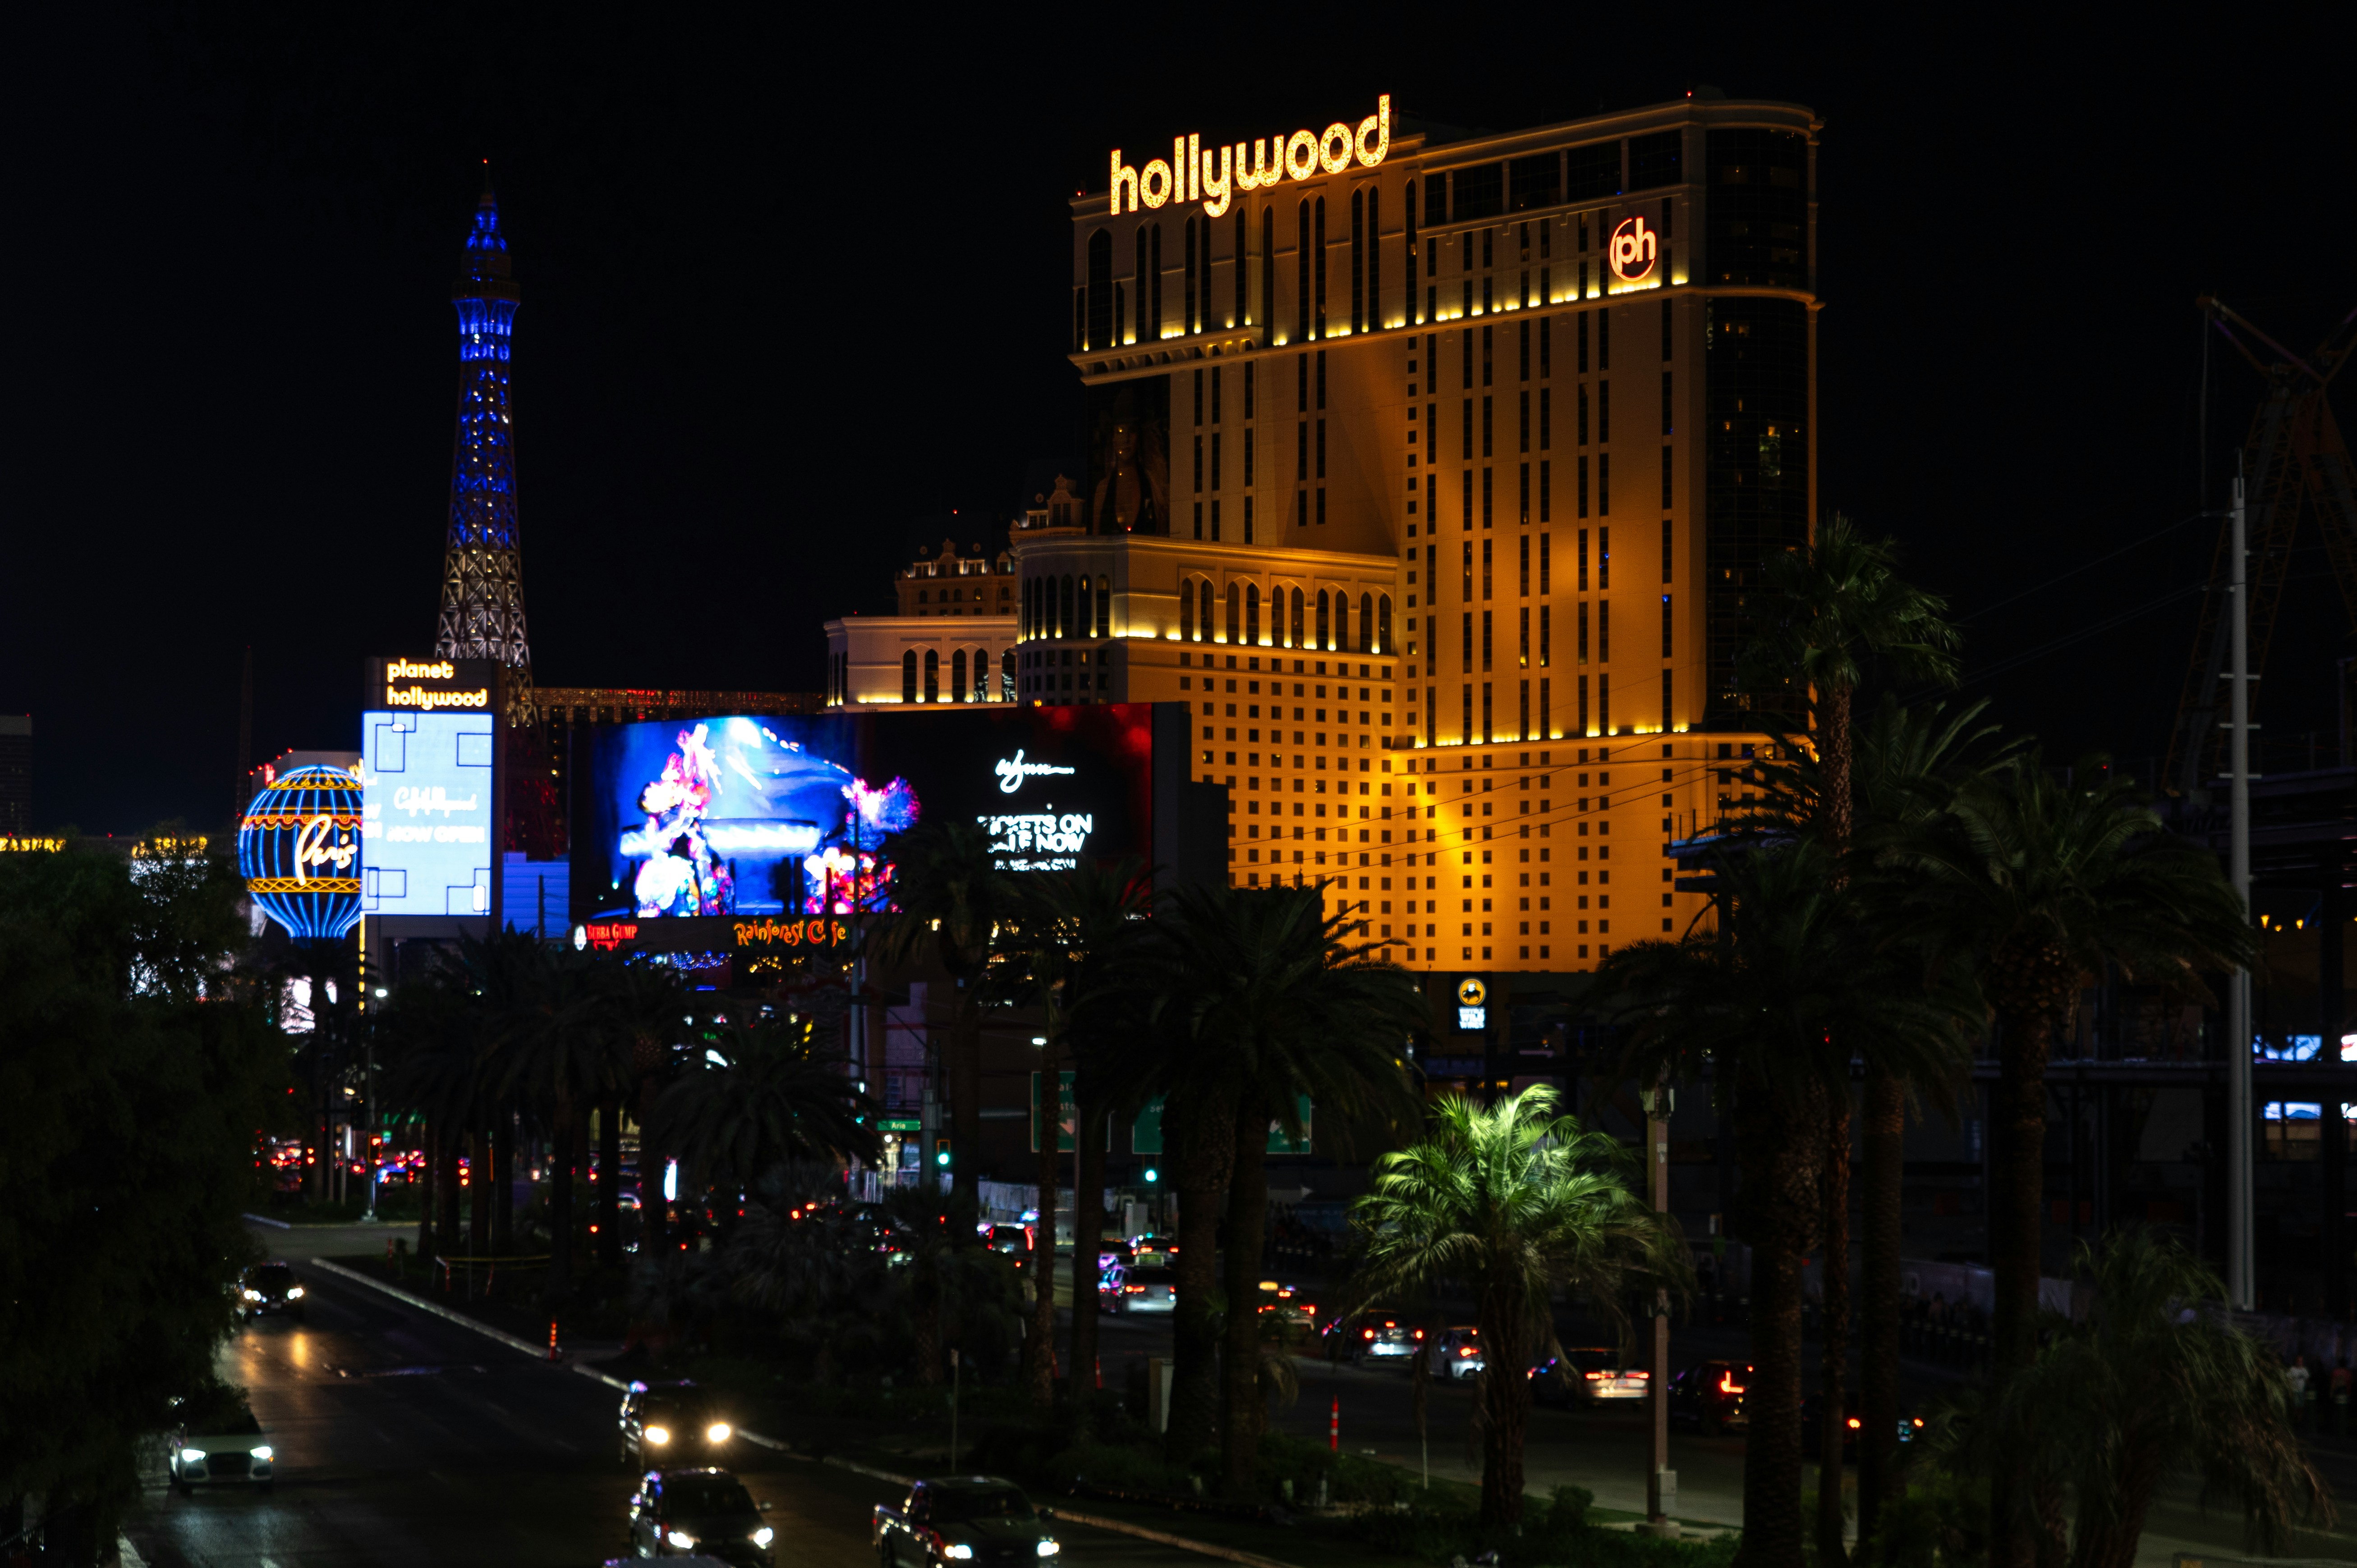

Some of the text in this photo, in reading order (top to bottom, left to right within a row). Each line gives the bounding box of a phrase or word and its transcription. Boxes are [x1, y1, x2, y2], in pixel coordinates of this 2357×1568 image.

[1111, 94, 1390, 217] hollywood
[387, 657, 454, 683] planet
[387, 685, 487, 711] hollywood
[386, 826, 433, 843] NOW
[433, 825, 485, 843] OPEN
[1059, 814, 1092, 834] ON
[294, 814, 358, 886] Paris
[1036, 832, 1085, 853] NOW
[611, 923, 638, 939] GUMP
[734, 918, 846, 947] Rainforest Cfe
